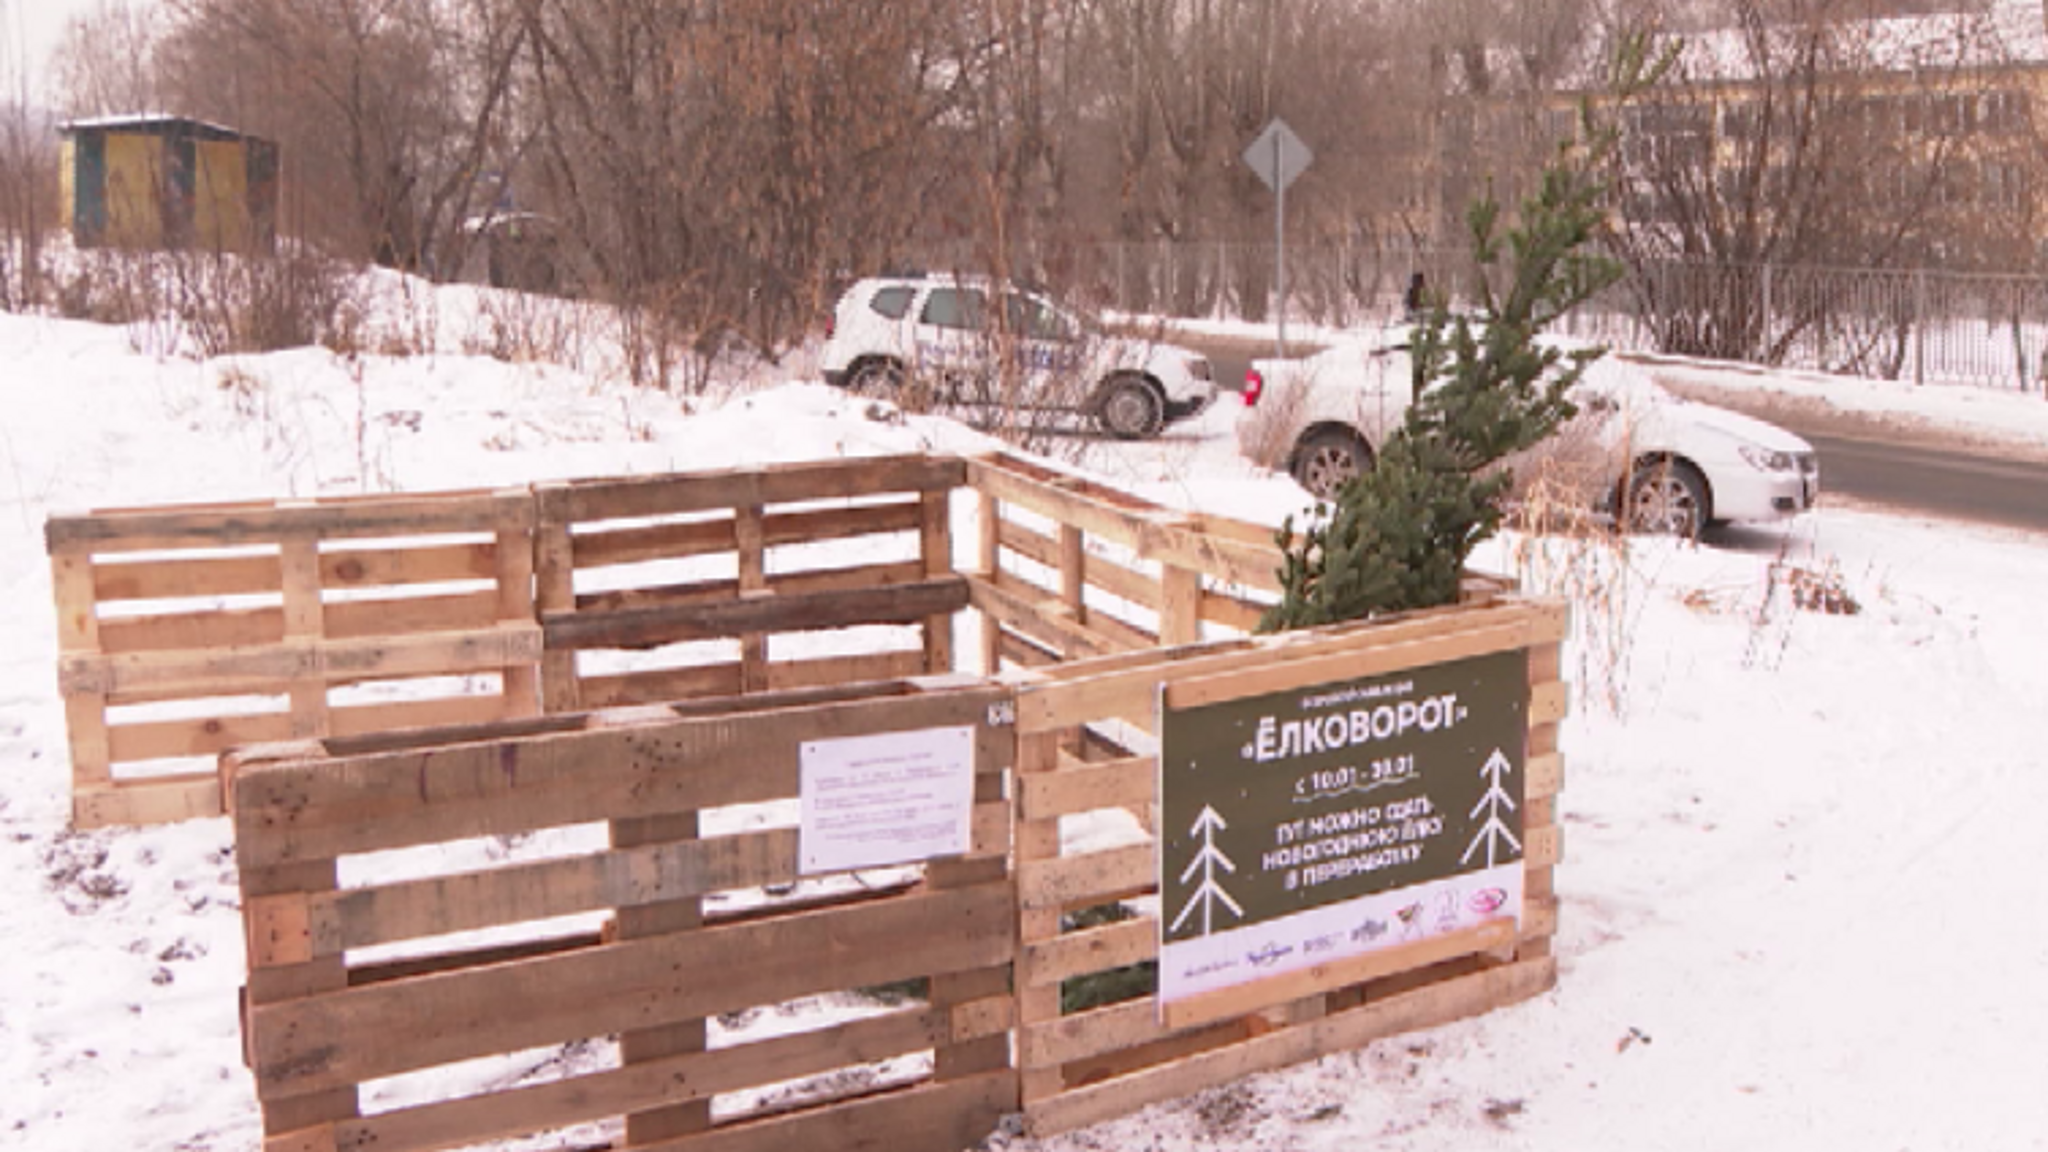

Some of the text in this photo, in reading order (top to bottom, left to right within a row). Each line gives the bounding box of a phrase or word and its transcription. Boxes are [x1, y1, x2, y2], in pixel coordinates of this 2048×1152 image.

[1311, 765, 1356, 791] 10.01
[1308, 806, 1380, 838] МОЖНО
[1262, 826, 1399, 871] НОВОГОДНЮЮ
